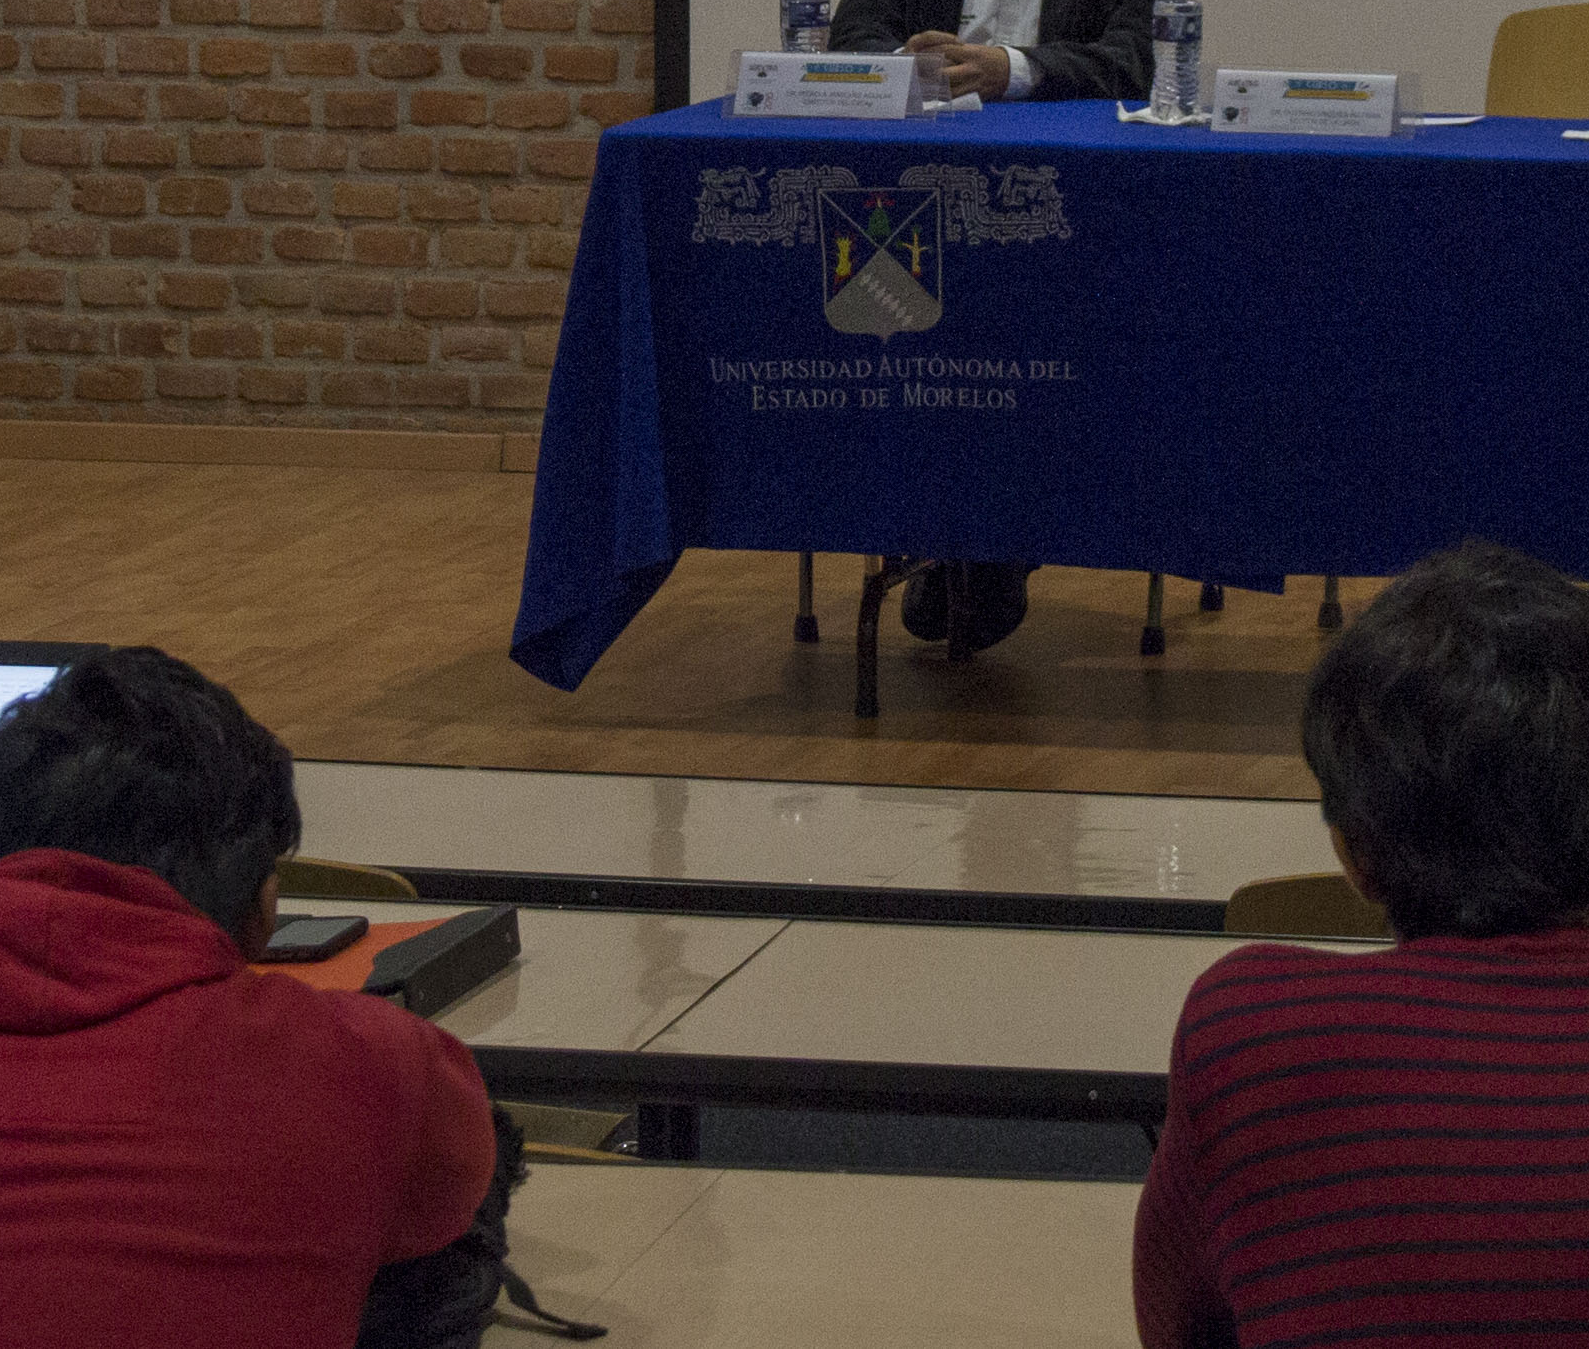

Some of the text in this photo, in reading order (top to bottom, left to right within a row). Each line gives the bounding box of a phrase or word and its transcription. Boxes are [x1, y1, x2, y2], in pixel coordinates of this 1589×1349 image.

[711, 353, 1077, 382] UNIVERSIDAD AUTÓNOMA DEL
[751, 382, 1019, 411] ESTADO DE MORELOS
